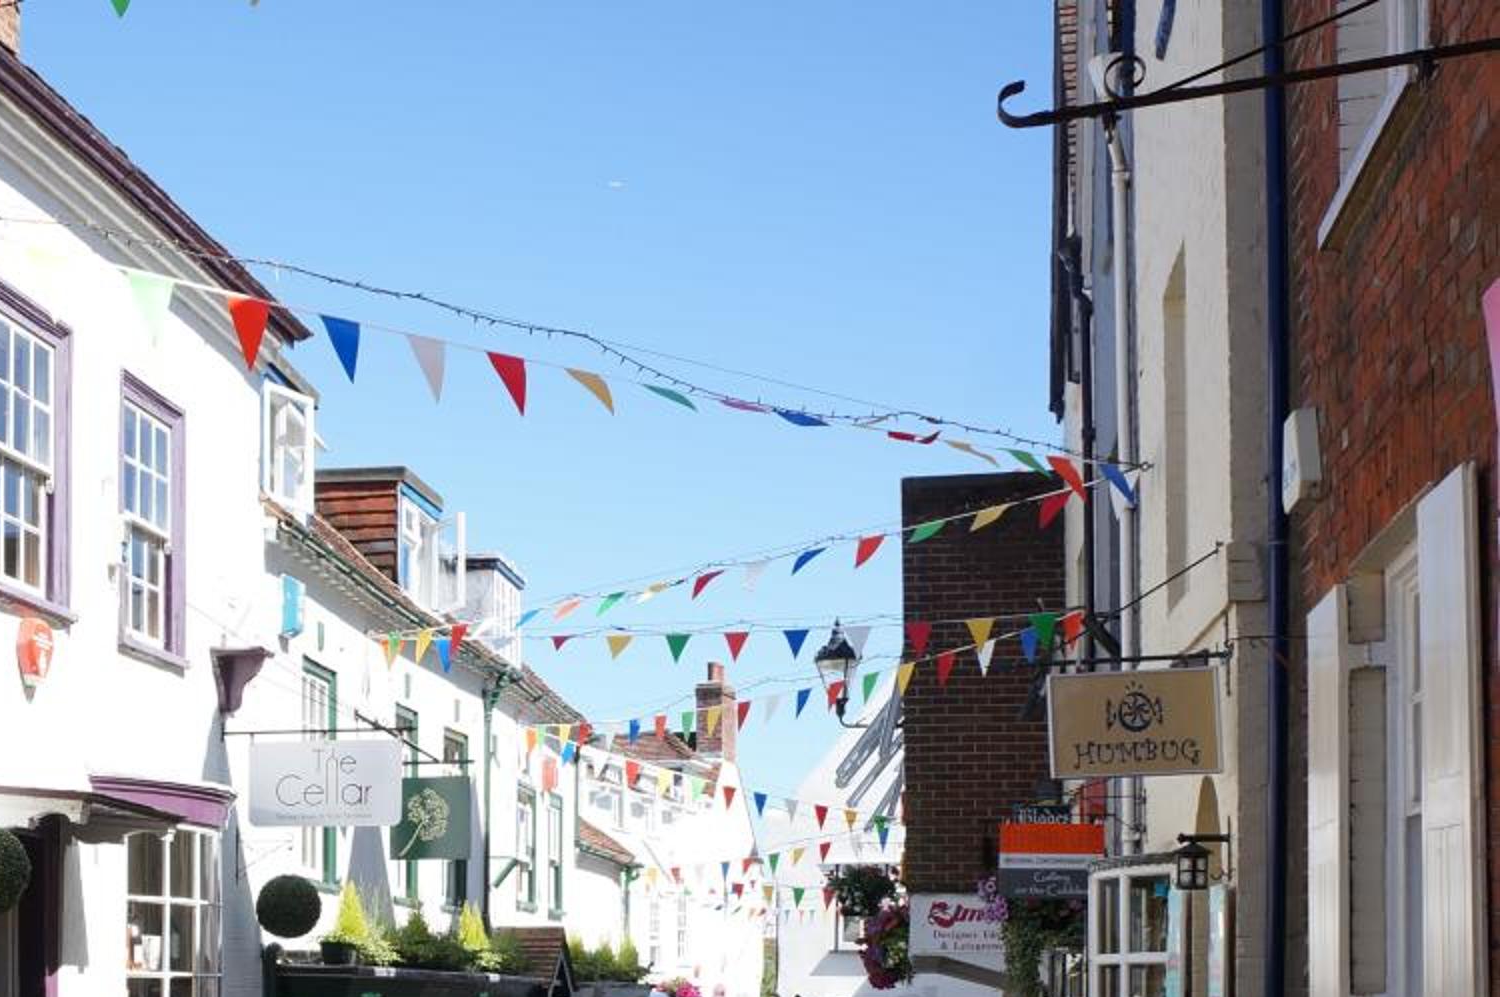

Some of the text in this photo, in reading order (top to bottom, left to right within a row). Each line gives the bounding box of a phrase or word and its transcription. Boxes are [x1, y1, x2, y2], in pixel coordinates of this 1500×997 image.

[311, 747, 357, 775] The
[1072, 737, 1202, 770] HUMBUG
[275, 772, 373, 807] Cellar
